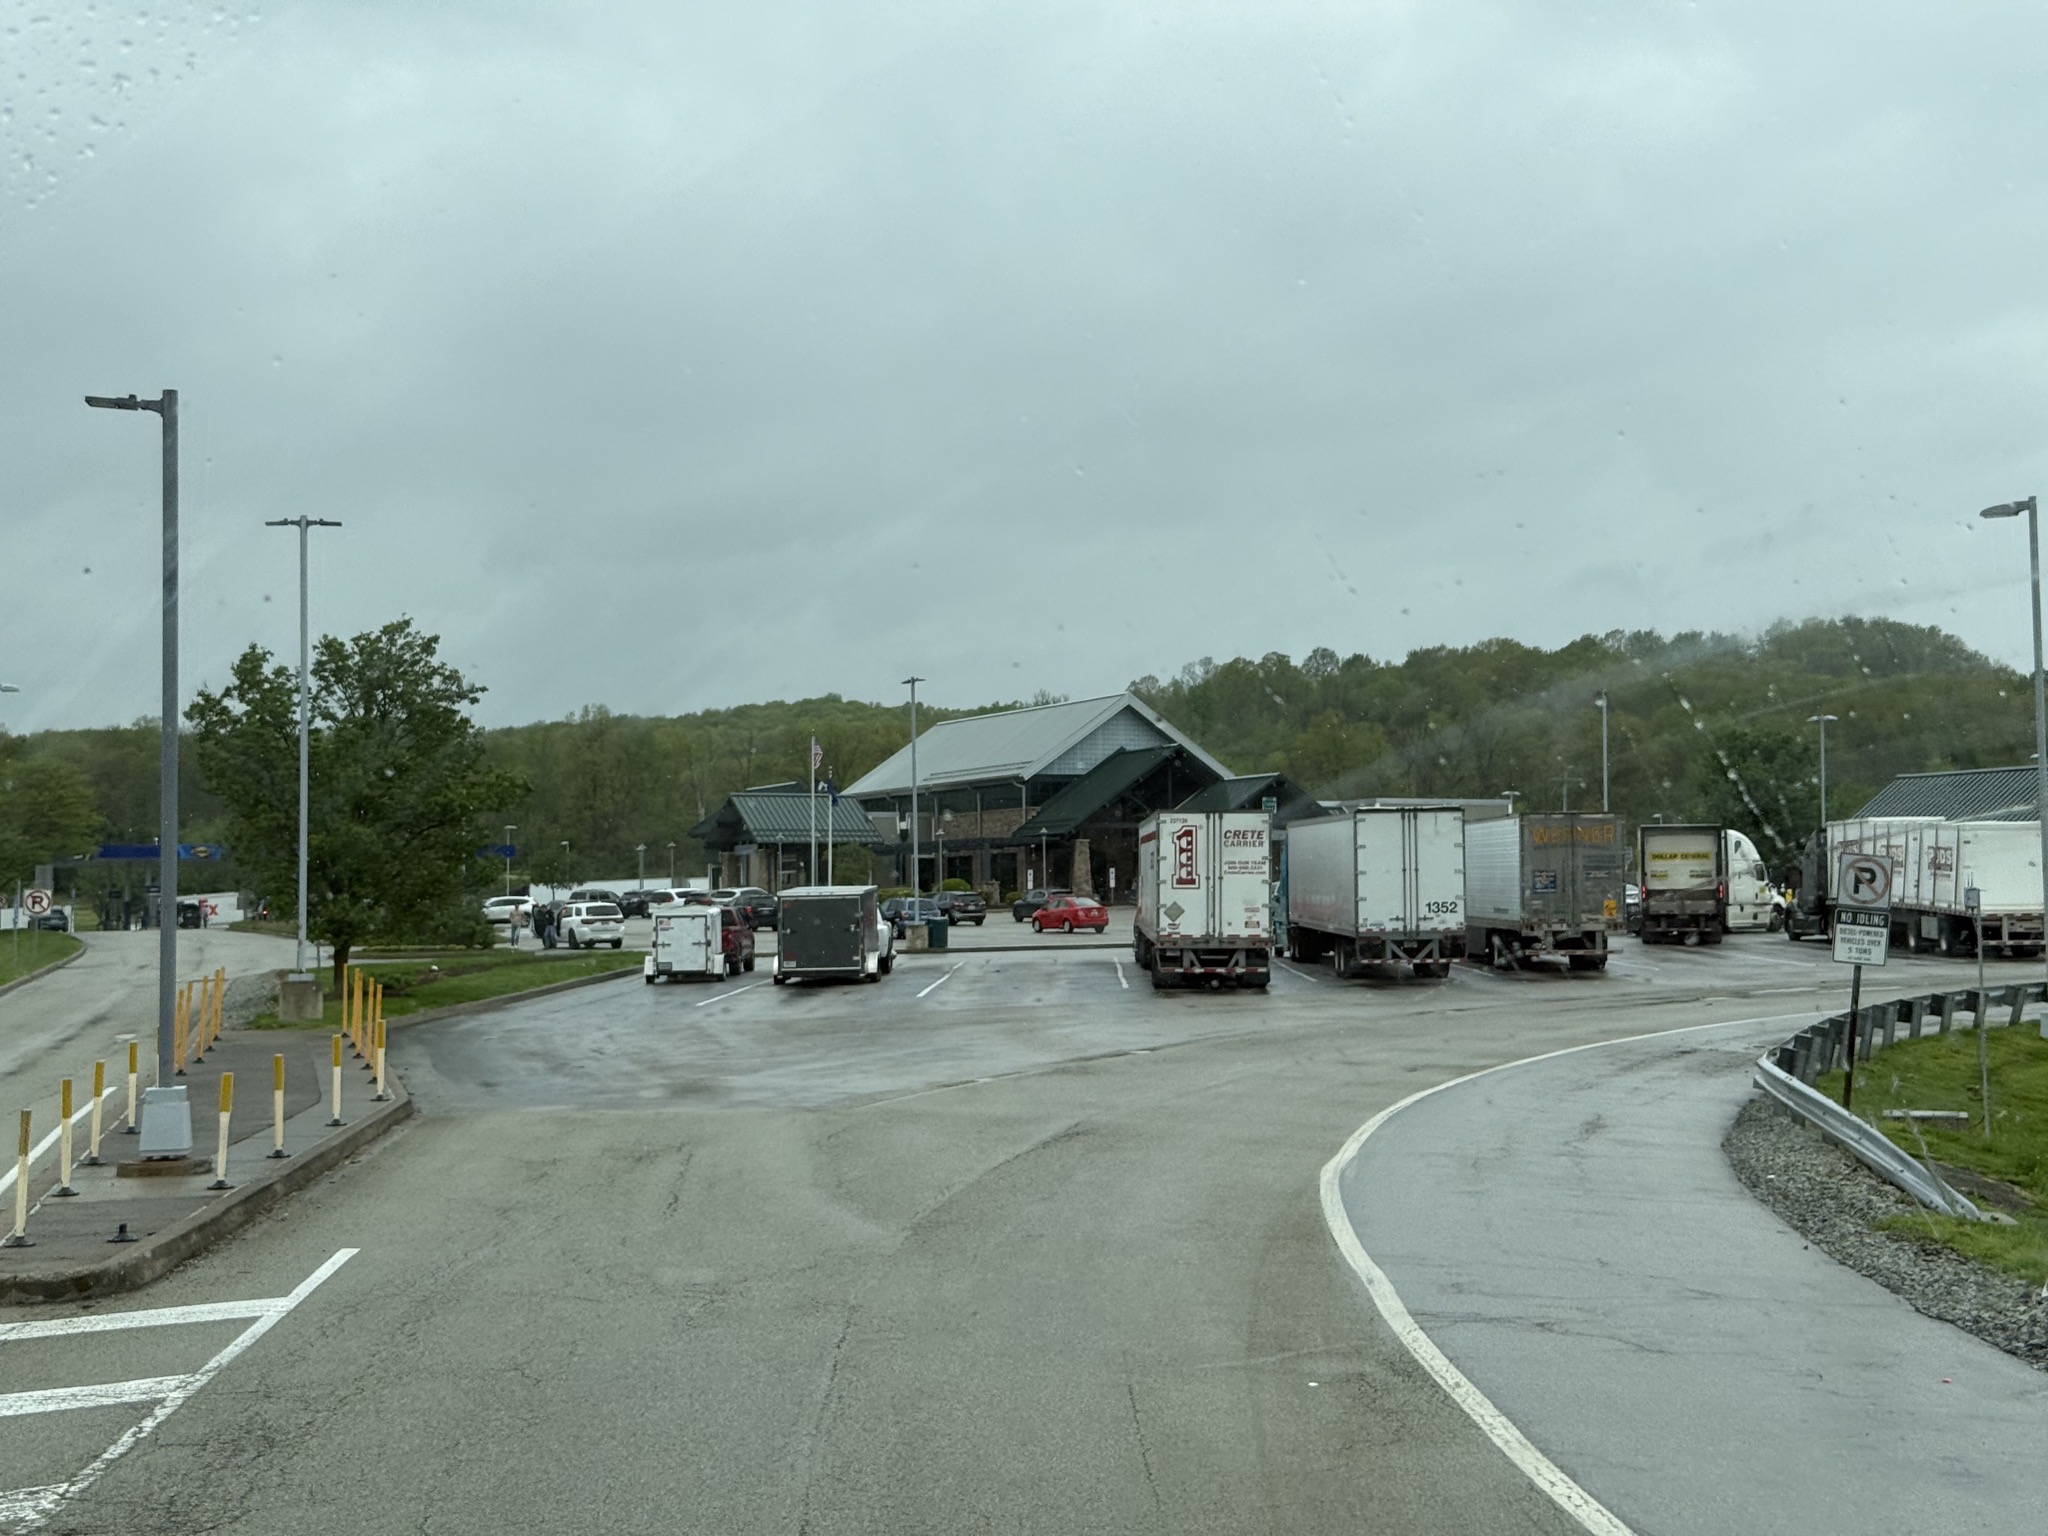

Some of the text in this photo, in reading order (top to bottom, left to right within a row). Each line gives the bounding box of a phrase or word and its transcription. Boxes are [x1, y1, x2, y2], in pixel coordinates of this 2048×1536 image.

[1223, 829, 1265, 840] CRETE
[1223, 840, 1265, 848] CARRIER
[1425, 901, 1458, 914] 1352
[1840, 911, 1885, 927] NO IDLING
